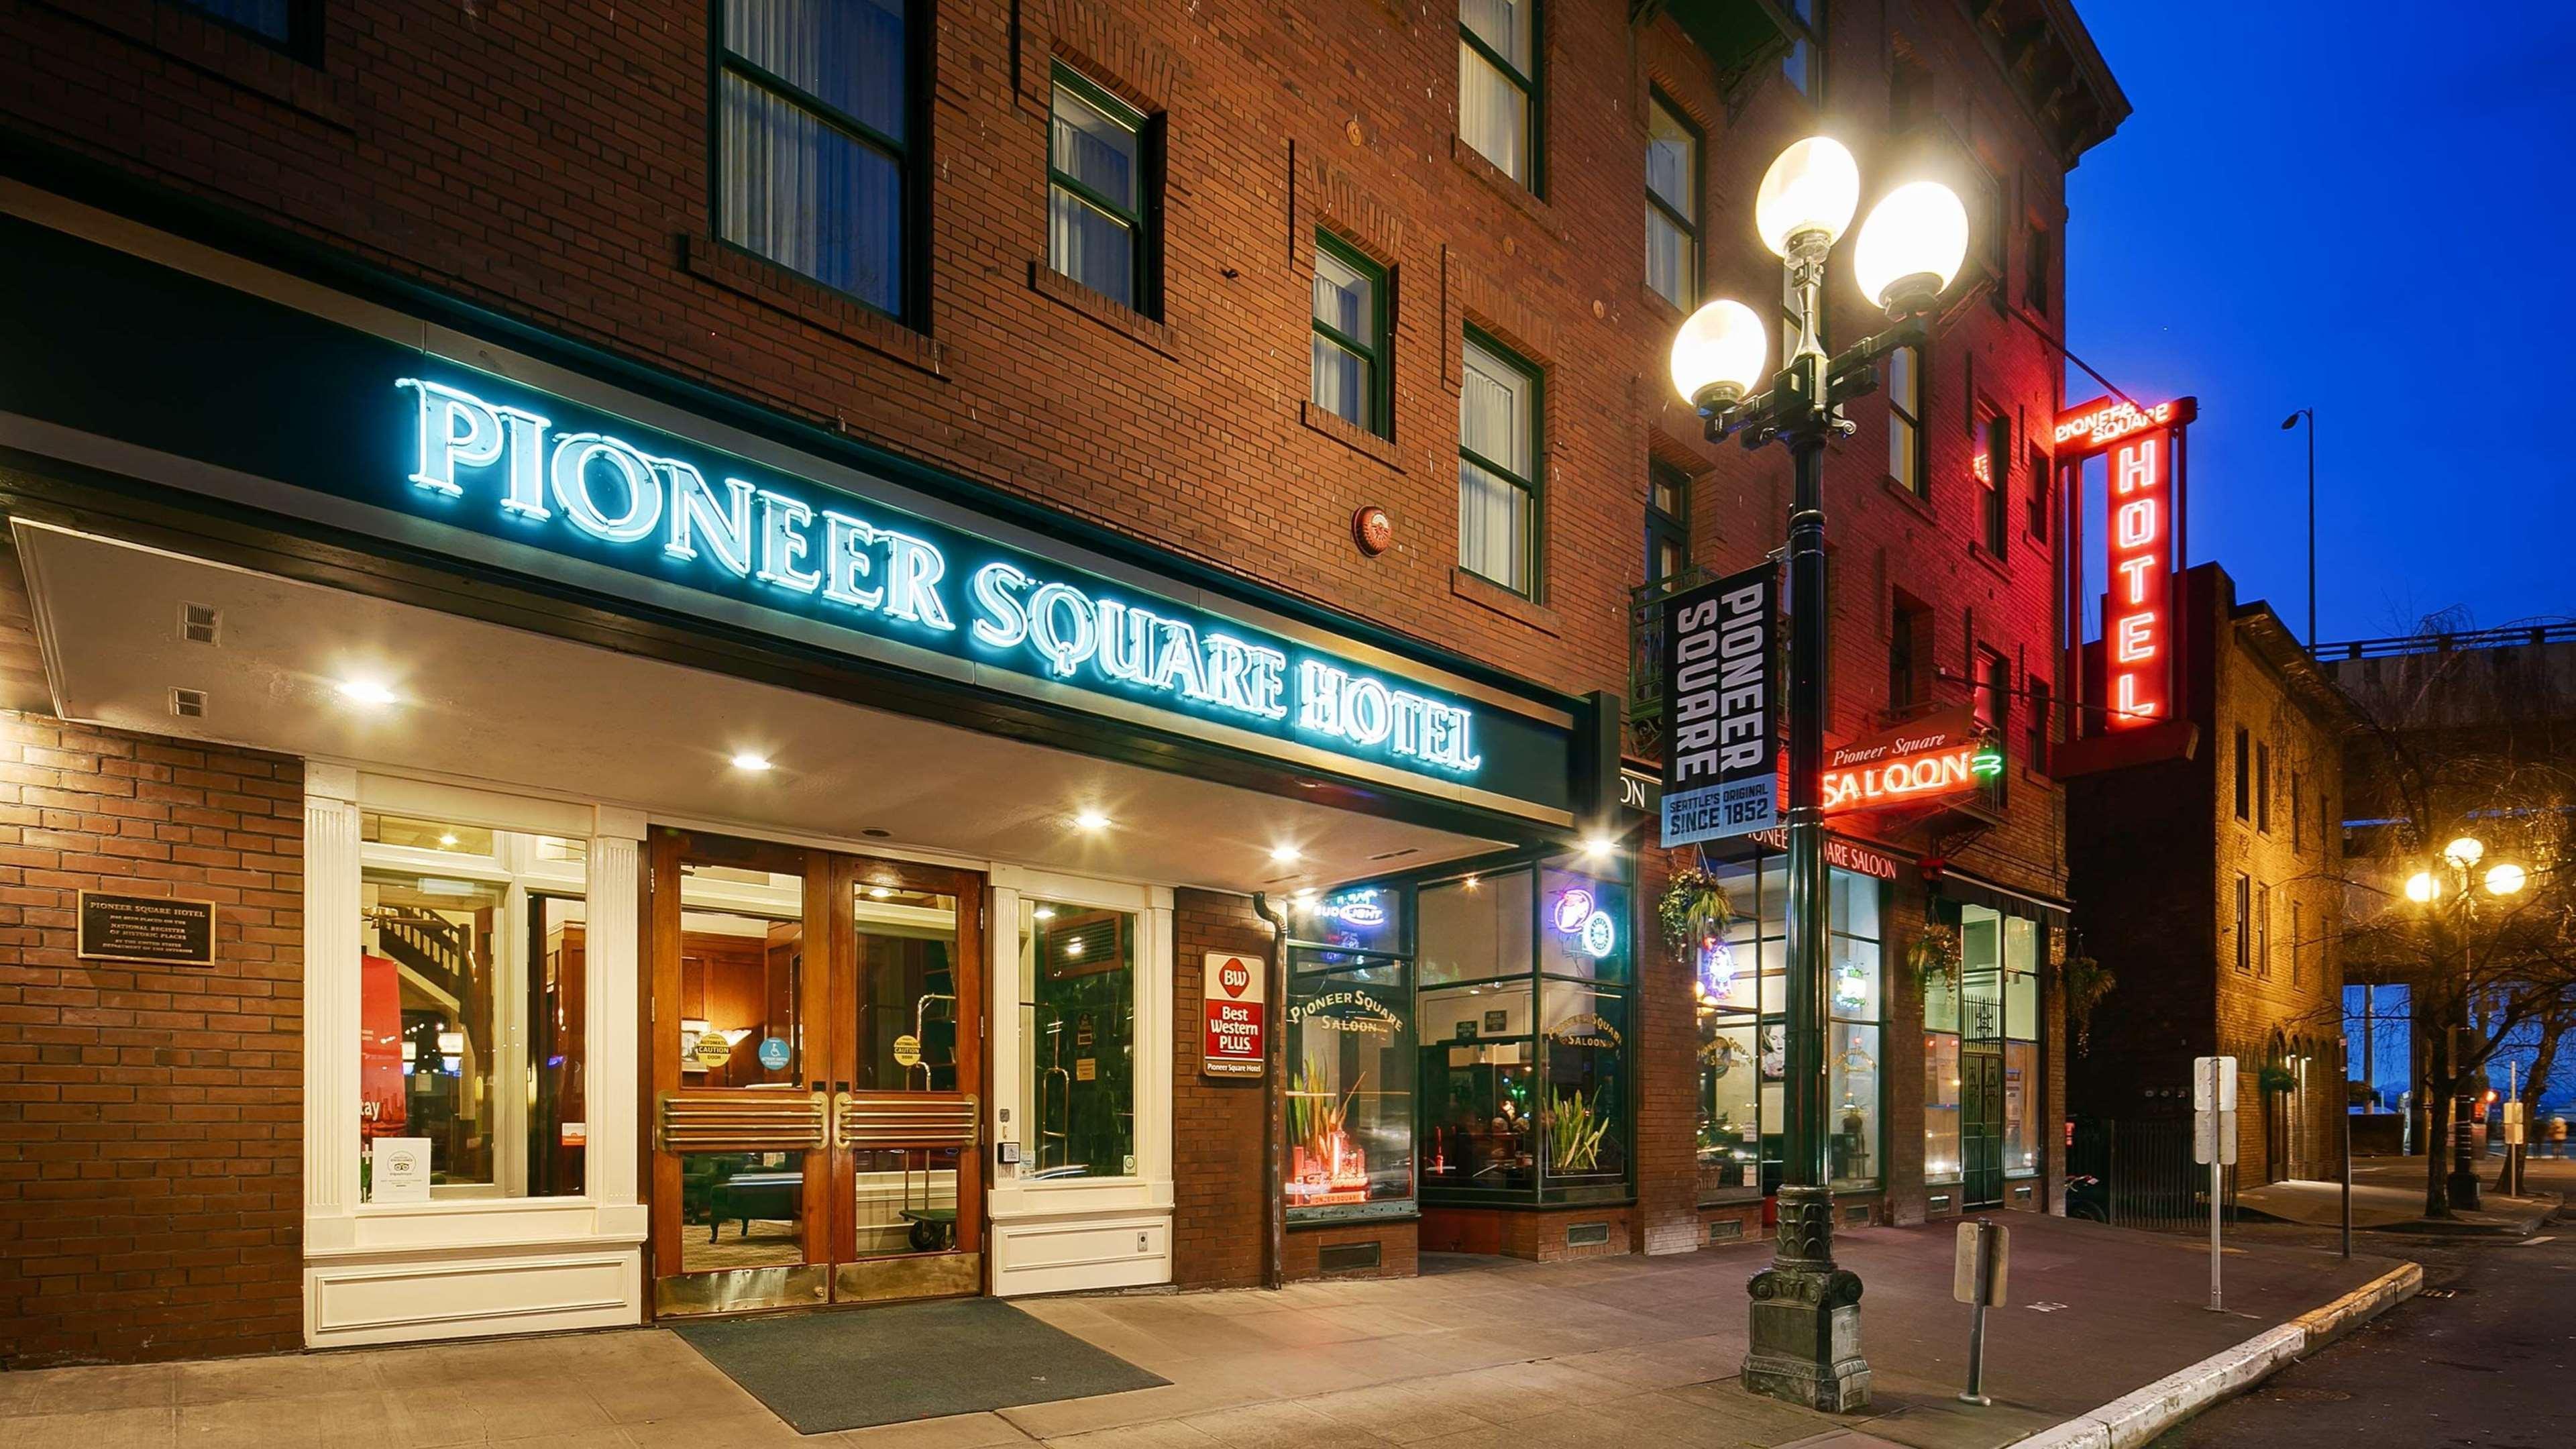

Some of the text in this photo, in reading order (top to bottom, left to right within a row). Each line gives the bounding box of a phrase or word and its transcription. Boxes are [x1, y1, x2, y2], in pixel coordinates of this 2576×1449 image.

[2092, 402, 2169, 443] SQUARE
[394, 378, 1481, 771] PIONEER SQUARE HOTEL
[2118, 439, 2156, 719] HOTEL
[1676, 598, 1717, 782] SQUARE
[1721, 582, 1764, 772] PIONEER
[1832, 734, 1945, 767] Pioneer Square
[1823, 751, 1971, 808] SALOON
[1670, 783, 1768, 813] SEATTLE'S ORIGINAL
[1724, 798, 1768, 825] 1852
[1851, 848, 1896, 879] SALOON
[90, 902, 205, 918] PIONEER SQUARE HOTEL
[1224, 969, 1247, 987] BW
[1210, 1019, 1258, 1036] Western
[1222, 1006, 1248, 1021] Best
[1219, 1035, 1251, 1051] PLUS
[1208, 1063, 1261, 1073] Pioneer Square Hotel
